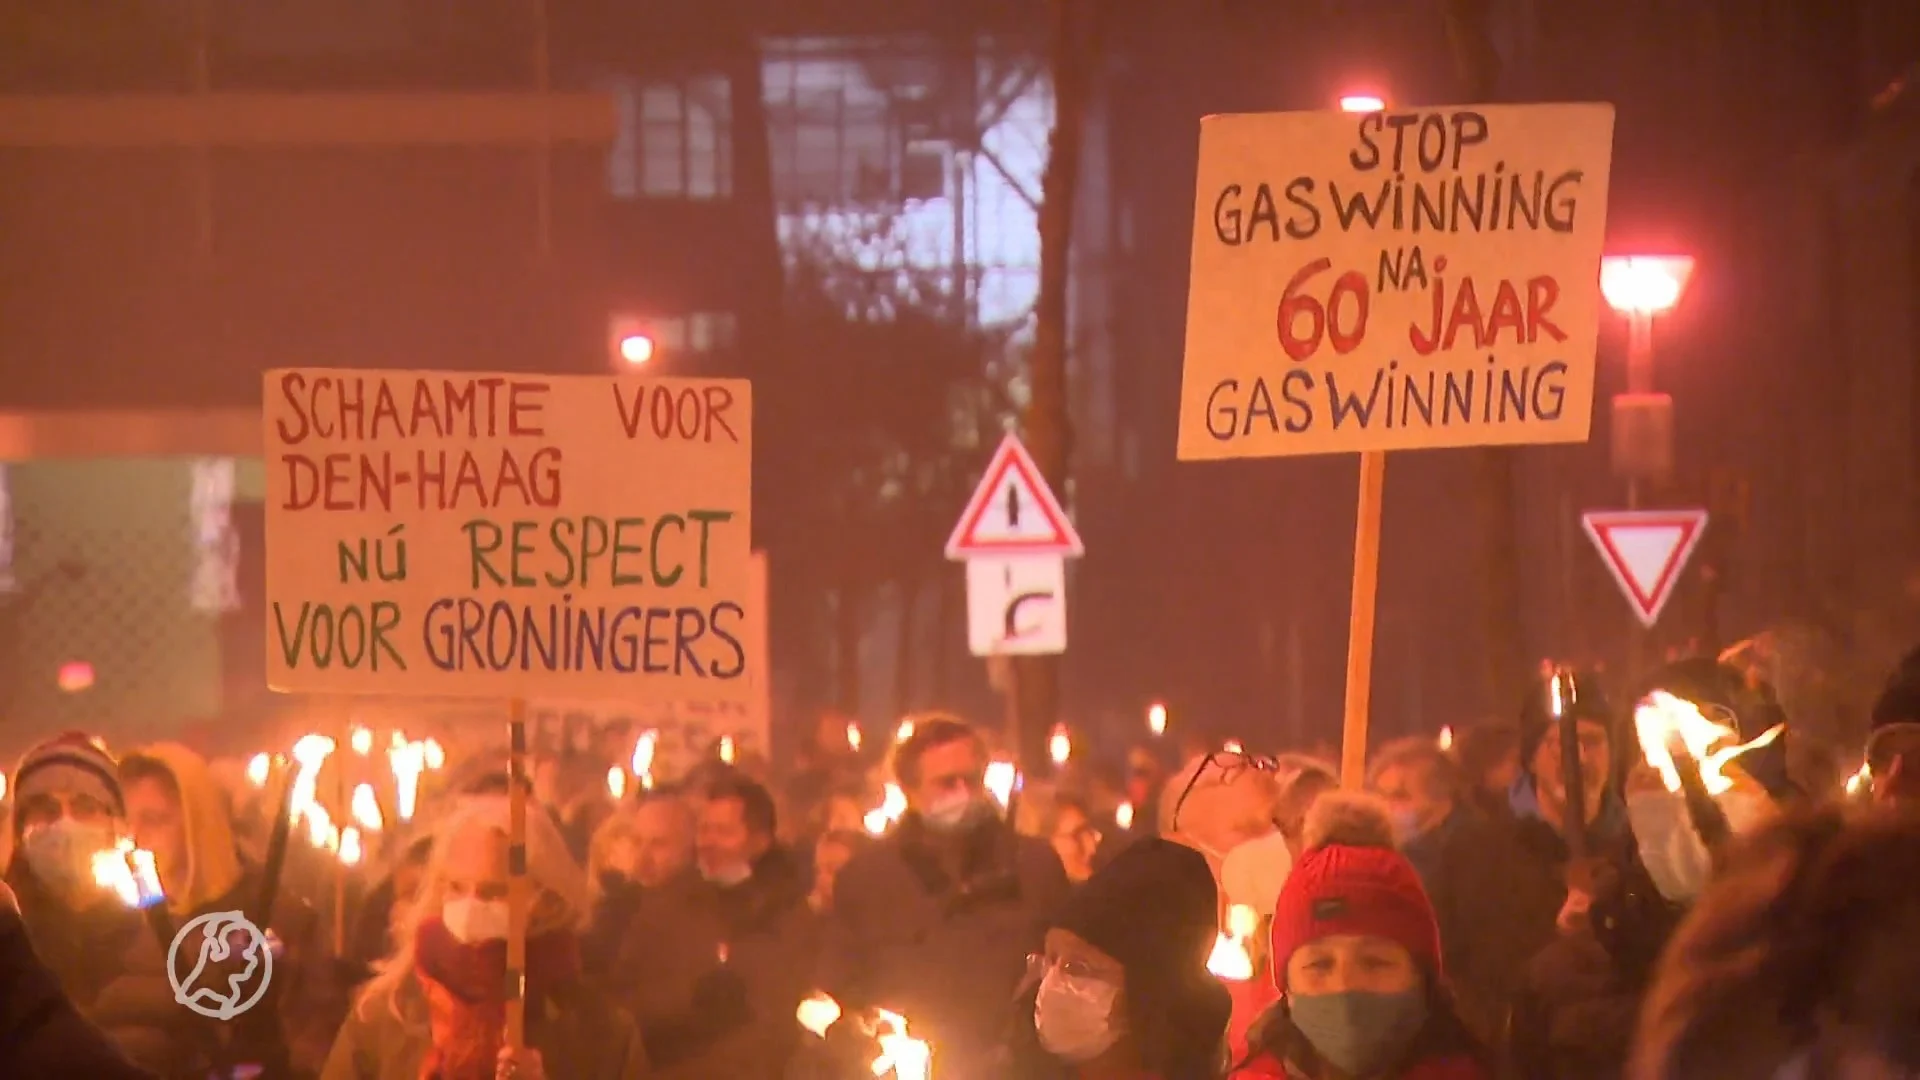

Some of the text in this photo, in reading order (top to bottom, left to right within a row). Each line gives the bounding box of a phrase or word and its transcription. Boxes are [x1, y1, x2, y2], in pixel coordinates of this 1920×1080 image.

[1349, 112, 1489, 172] STOP
[1378, 246, 1427, 293] NA
[1277, 257, 1370, 362] 60
[276, 372, 739, 445] SCHAAMTE VOOR
[282, 447, 562, 512] DEN-HAAG
[462, 510, 734, 589] RESPECT
[273, 600, 407, 671] VOOR
